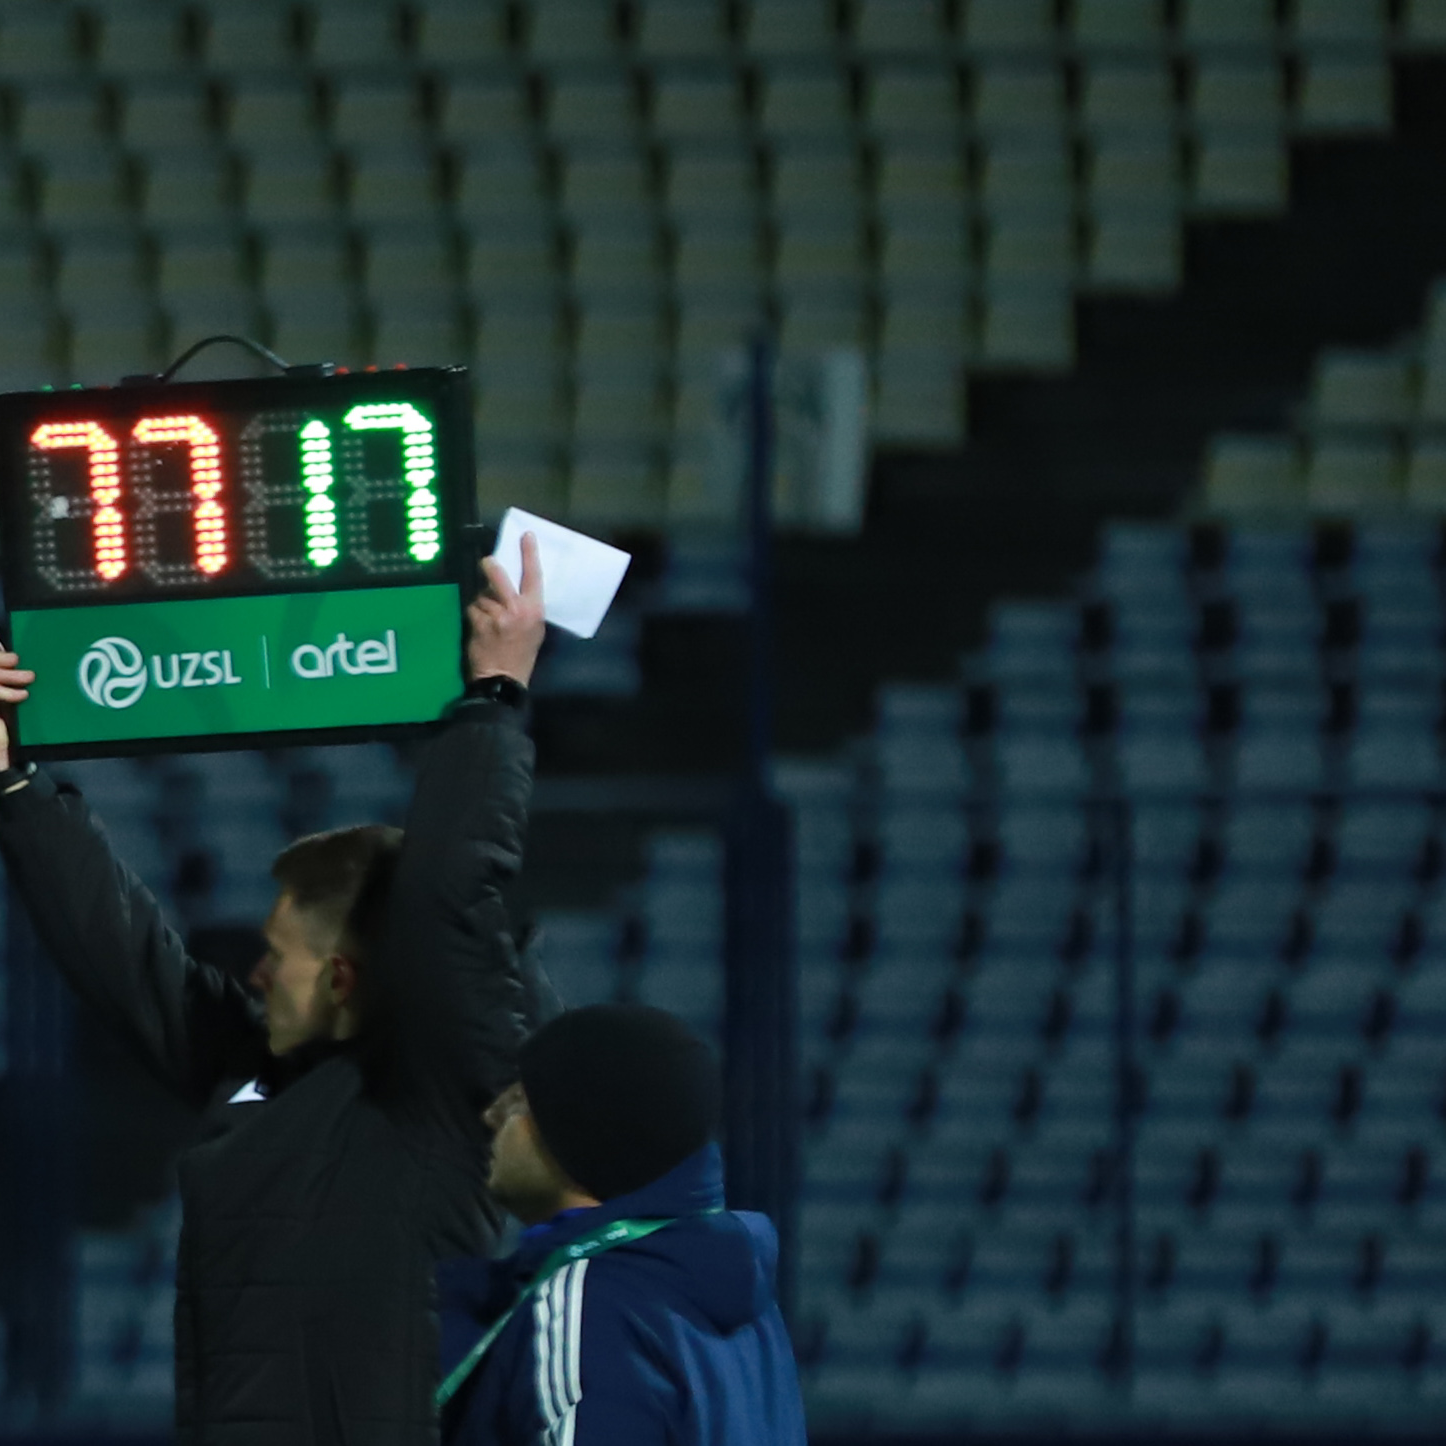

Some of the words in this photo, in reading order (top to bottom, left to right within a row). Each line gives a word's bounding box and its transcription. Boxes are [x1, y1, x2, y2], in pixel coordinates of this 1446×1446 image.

[30, 414, 228, 581] 77
[299, 401, 442, 568] 17
[152, 650, 242, 688] UZSL
[292, 629, 398, 679] artel
